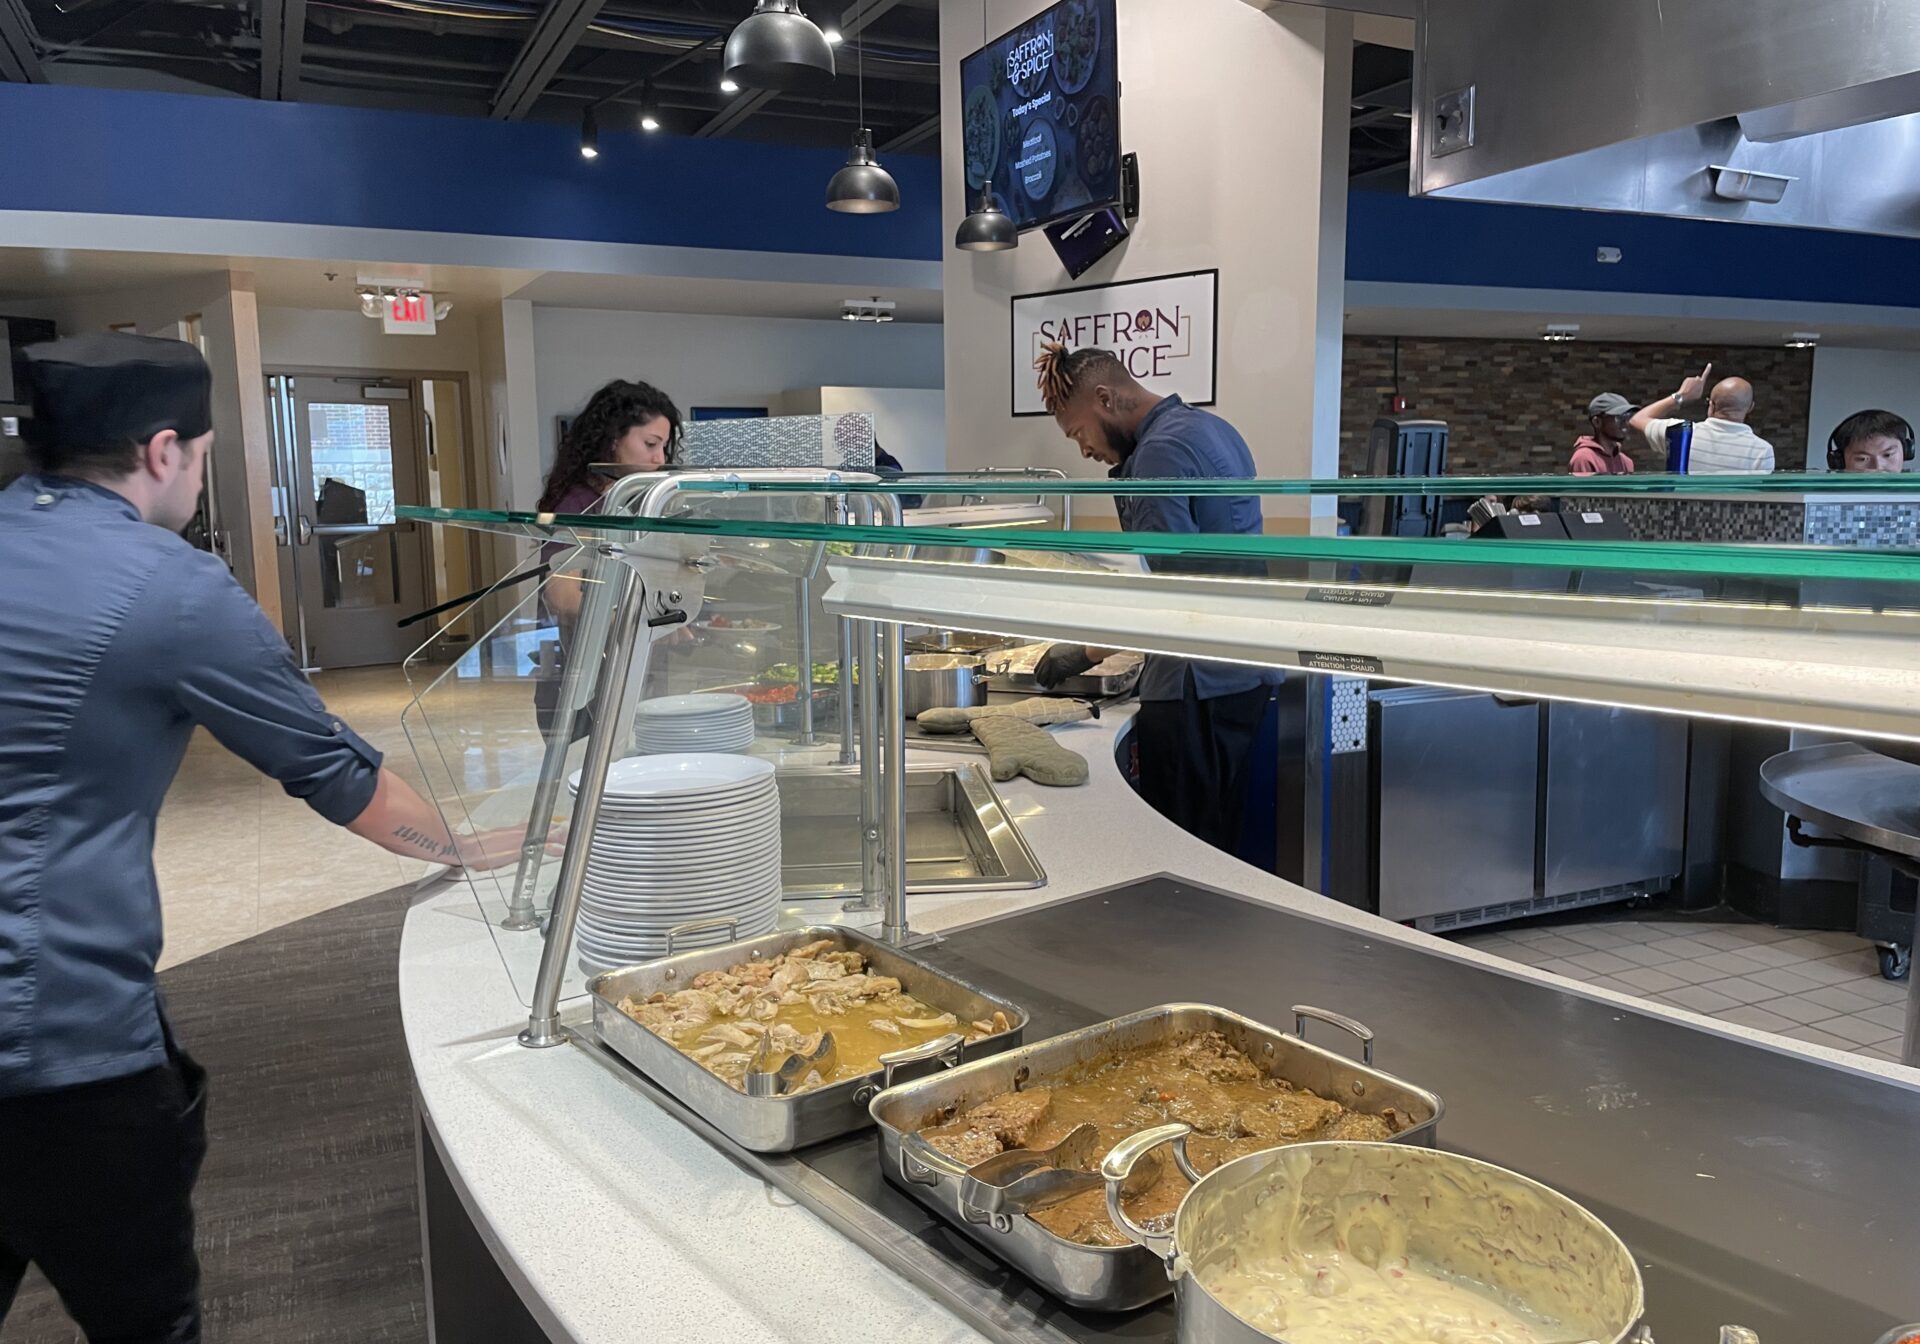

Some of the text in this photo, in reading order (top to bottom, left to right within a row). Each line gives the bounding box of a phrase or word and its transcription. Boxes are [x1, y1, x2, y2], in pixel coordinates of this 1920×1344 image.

[1009, 29, 1051, 67] SAFFRON
[1012, 90, 1051, 118] Today's Special
[391, 295, 426, 321] EXIT
[1040, 305, 1180, 347] SAFFRON
[1309, 661, 1345, 669] ATTENTION
[1315, 654, 1345, 662] CAUTION
[1350, 656, 1364, 664] HOT
